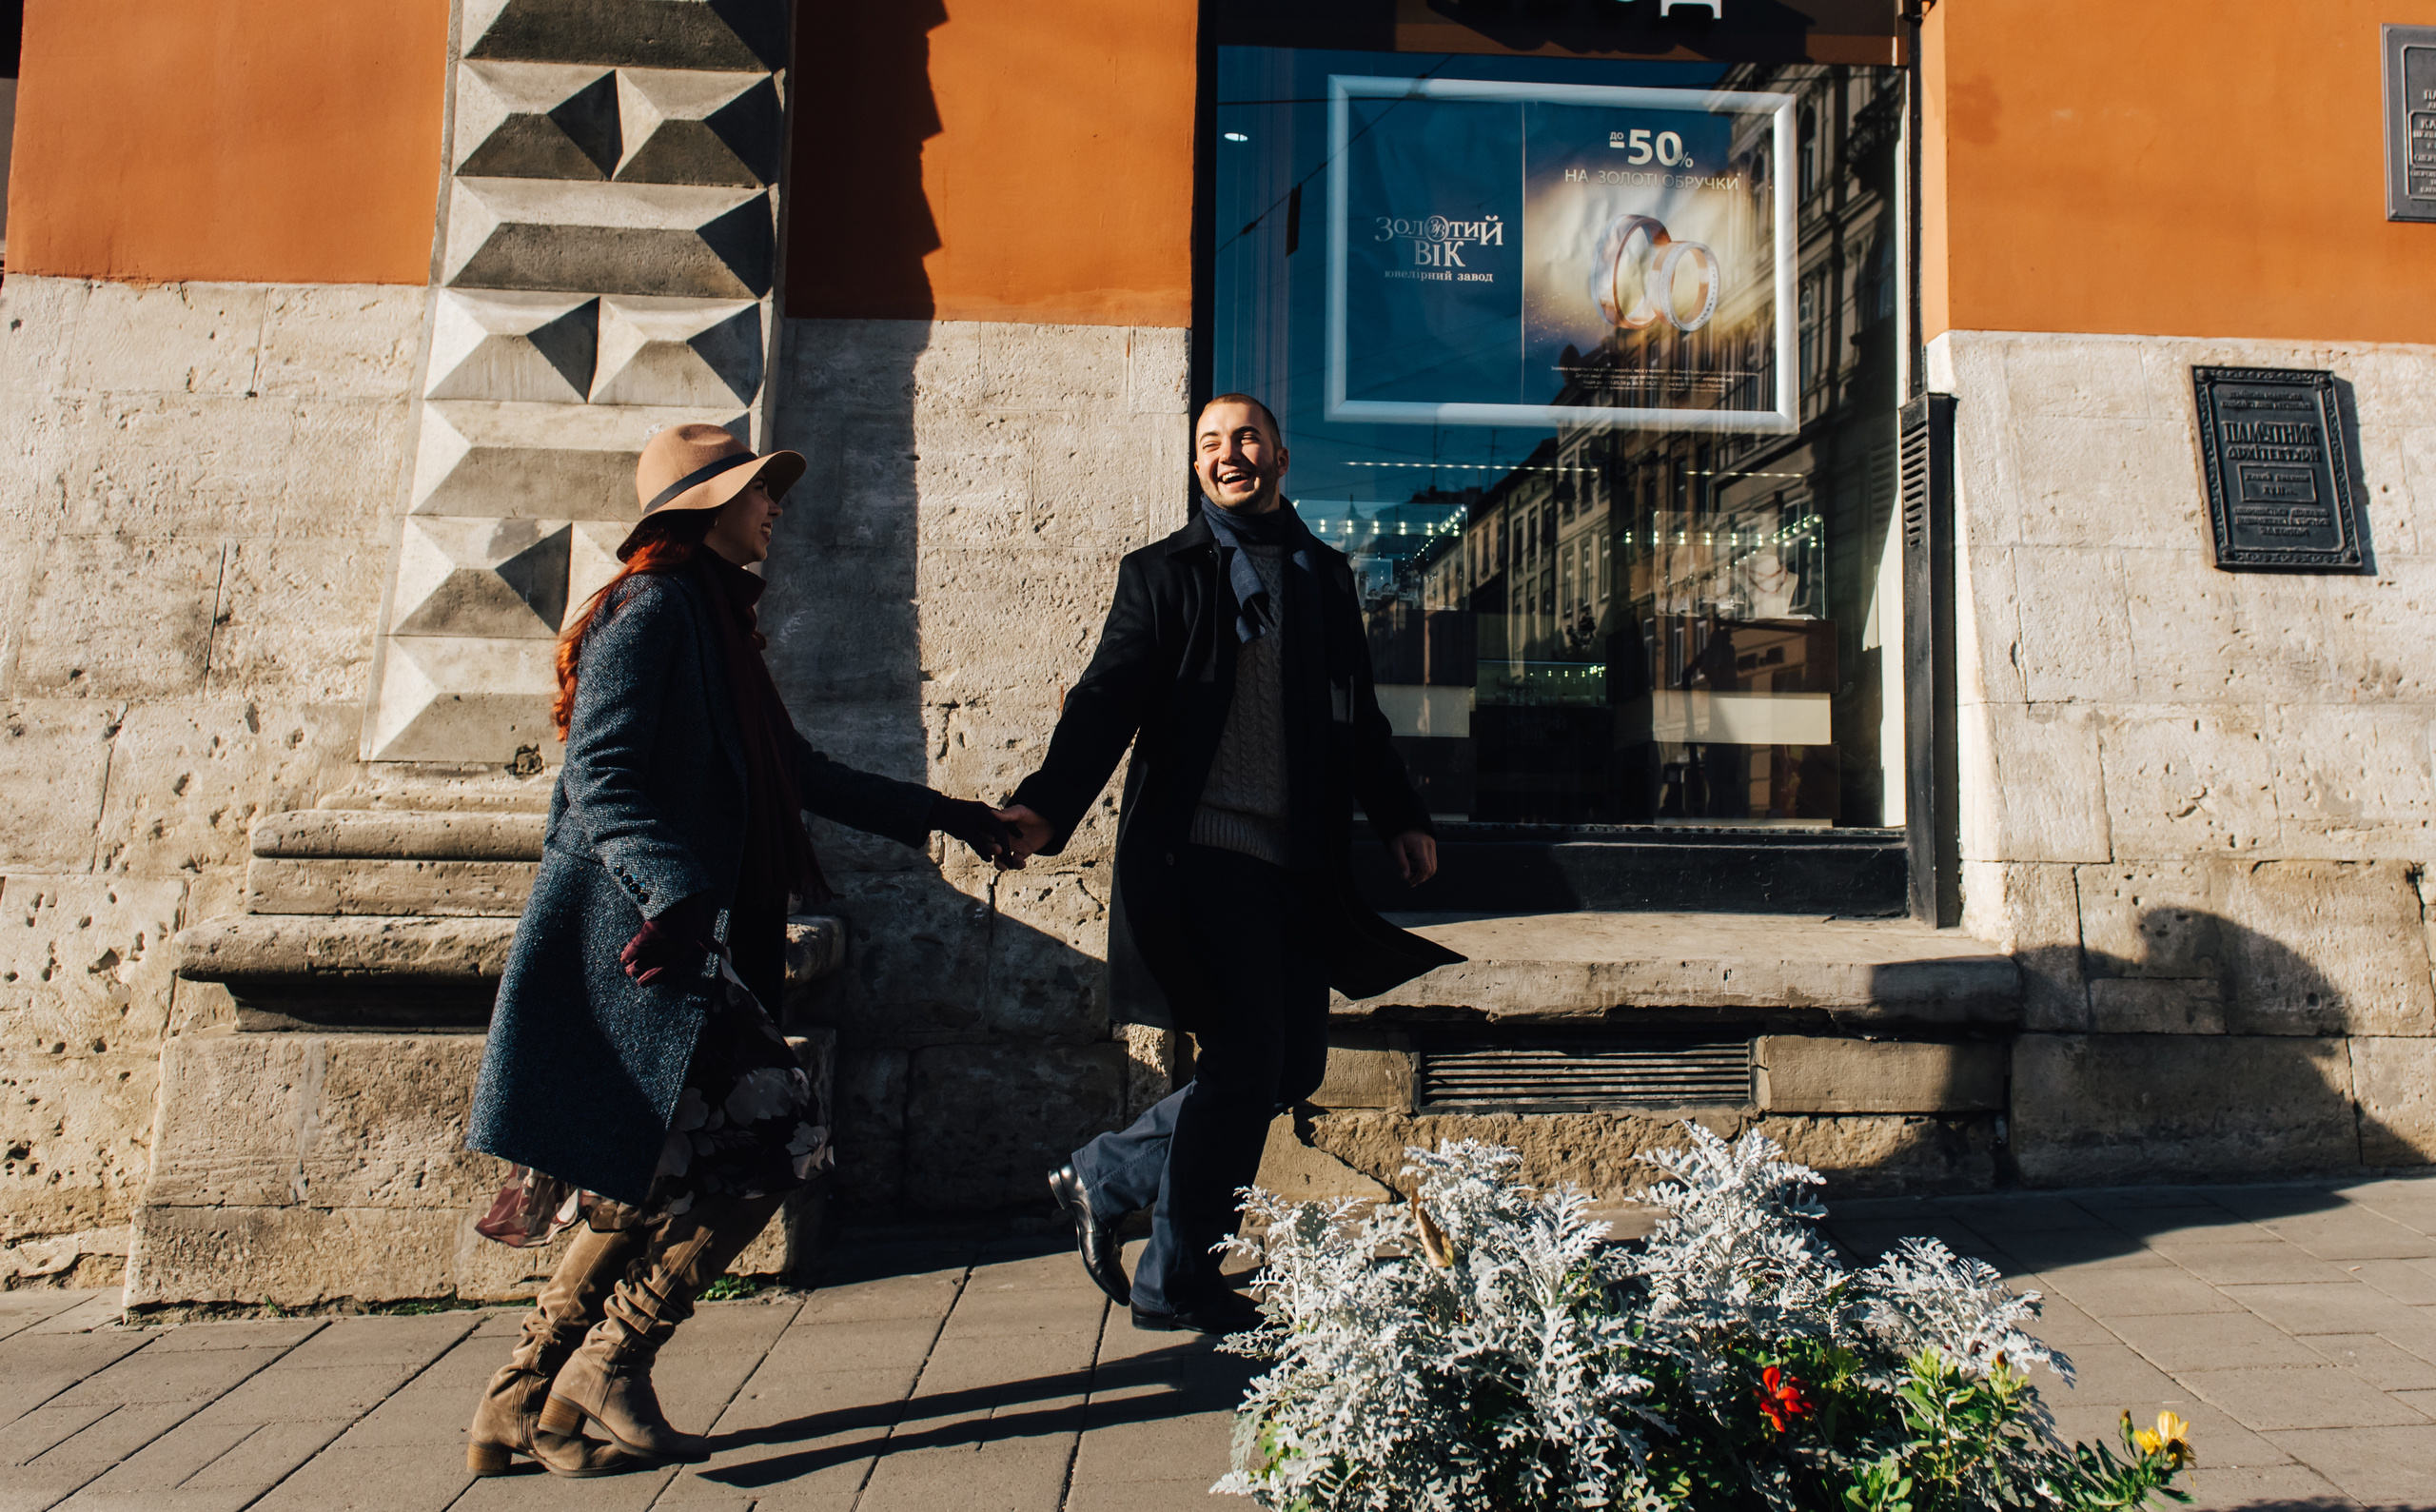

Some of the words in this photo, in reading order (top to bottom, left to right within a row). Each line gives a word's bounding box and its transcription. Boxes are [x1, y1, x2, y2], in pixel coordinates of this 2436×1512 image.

[1564, 169, 1589, 183] НА
[1598, 170, 1658, 187] ЗОЛОТІ
[1385, 268, 1453, 282] ювелірний
[1457, 272, 1494, 283] завод
